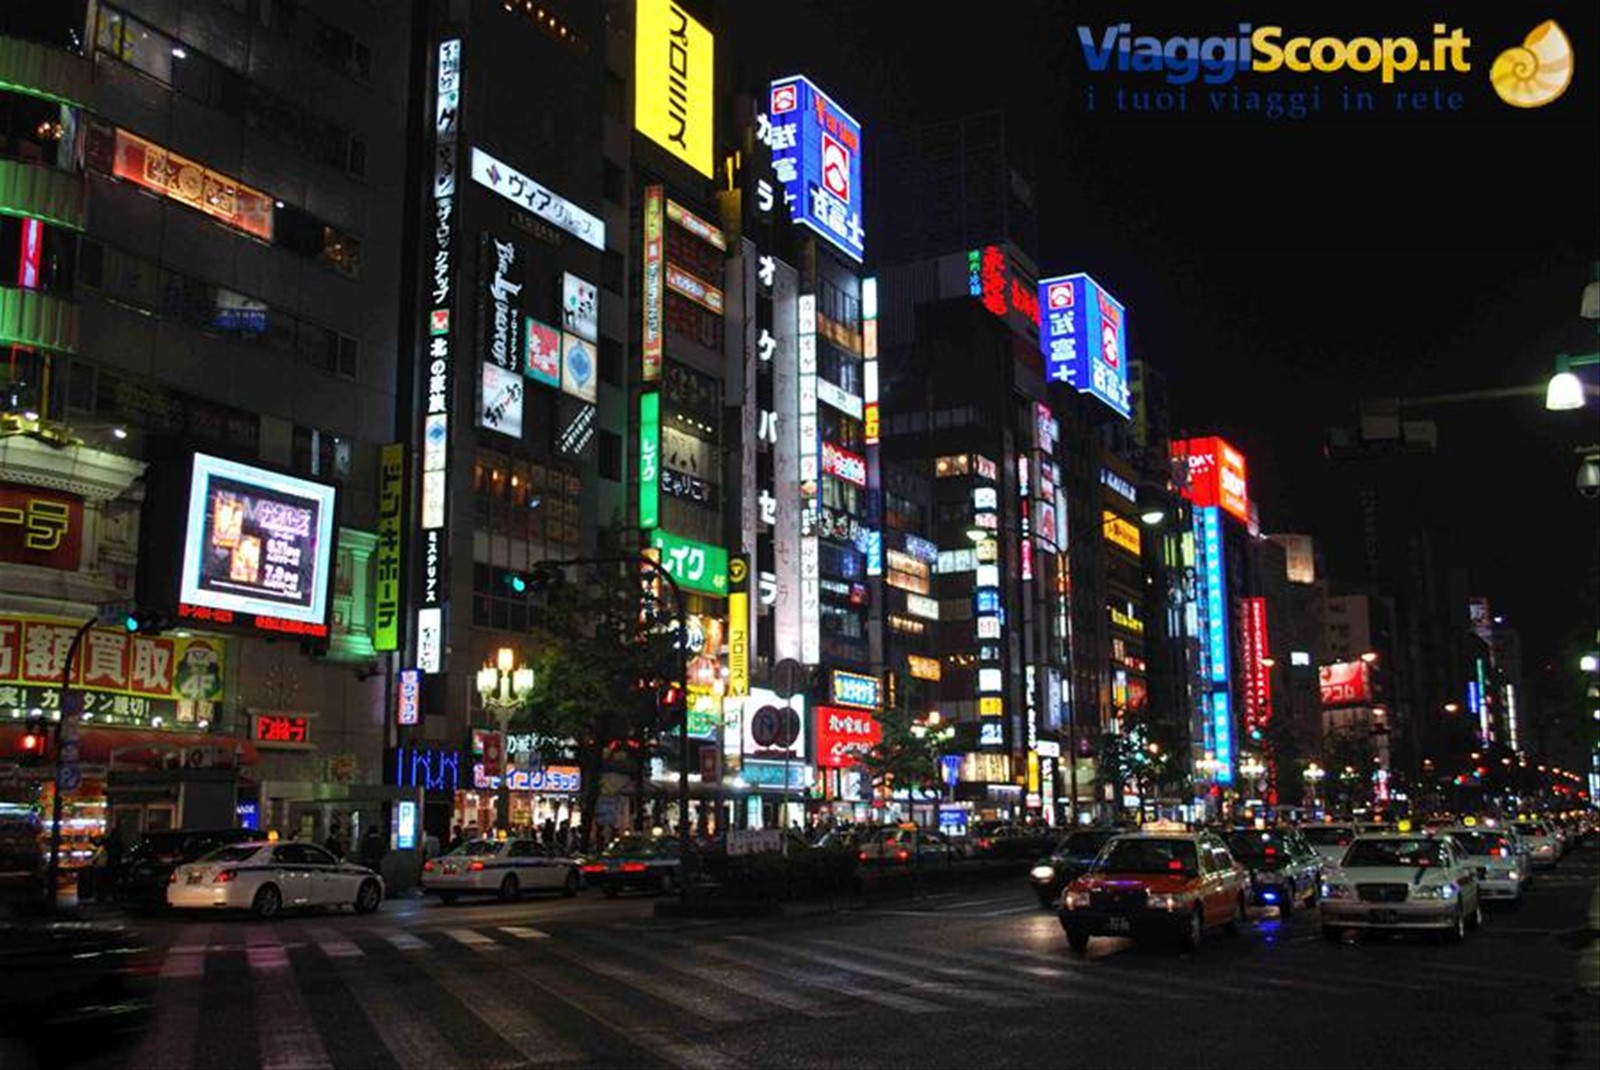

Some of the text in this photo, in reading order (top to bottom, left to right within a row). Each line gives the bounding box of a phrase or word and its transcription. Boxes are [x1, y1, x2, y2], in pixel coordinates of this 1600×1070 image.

[668, 5, 689, 150] プロミス
[41, 689, 150, 716] カタン親切!
